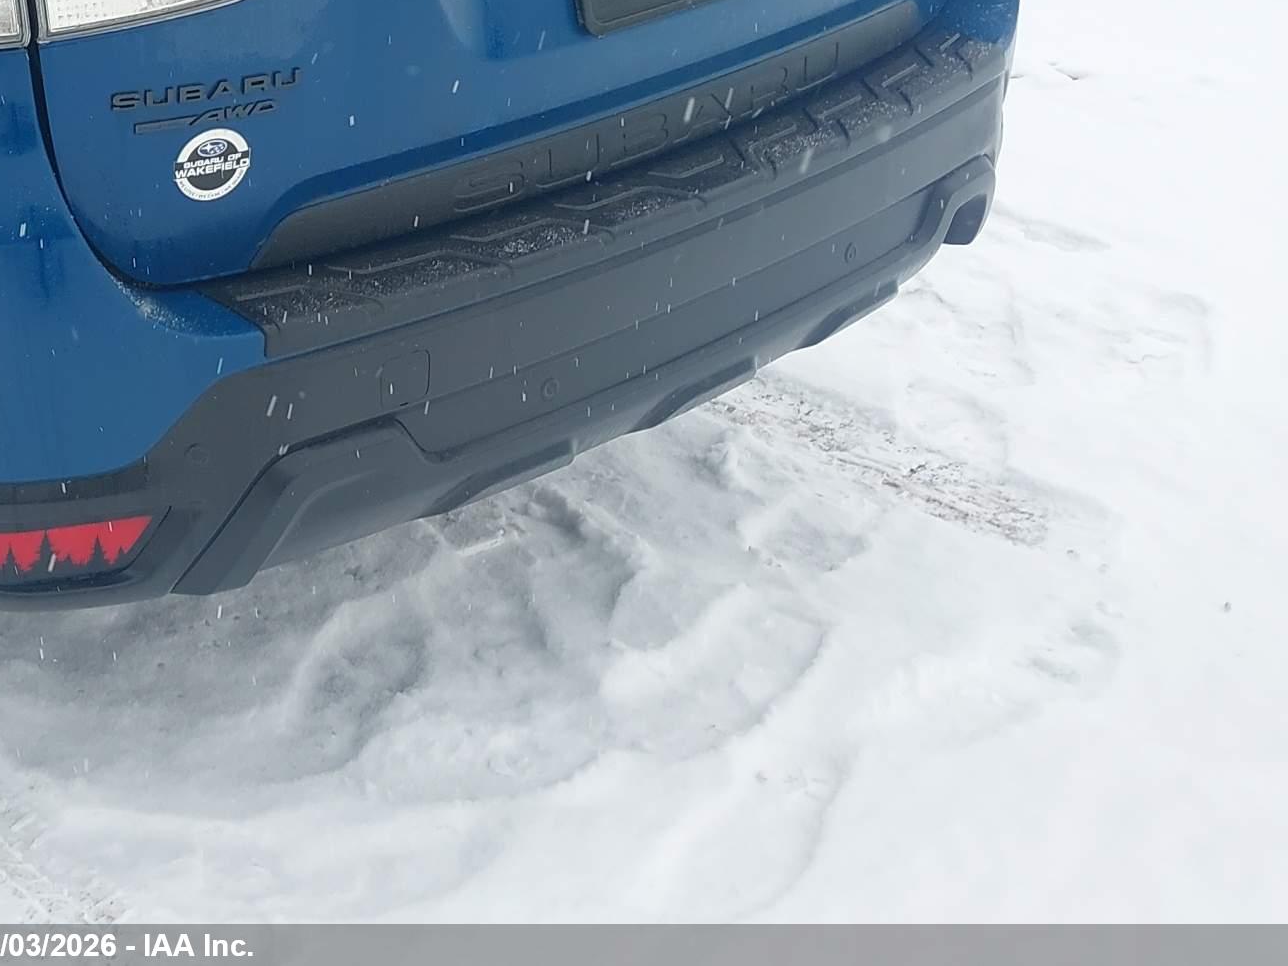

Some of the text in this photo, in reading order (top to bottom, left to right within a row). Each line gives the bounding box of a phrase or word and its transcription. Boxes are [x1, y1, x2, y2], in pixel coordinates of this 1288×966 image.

[110, 66, 303, 112] SUBARU
[189, 99, 278, 126] AWD
[174, 157, 250, 179] WAKEFIELD
[183, 152, 242, 169] SUBARU OF
